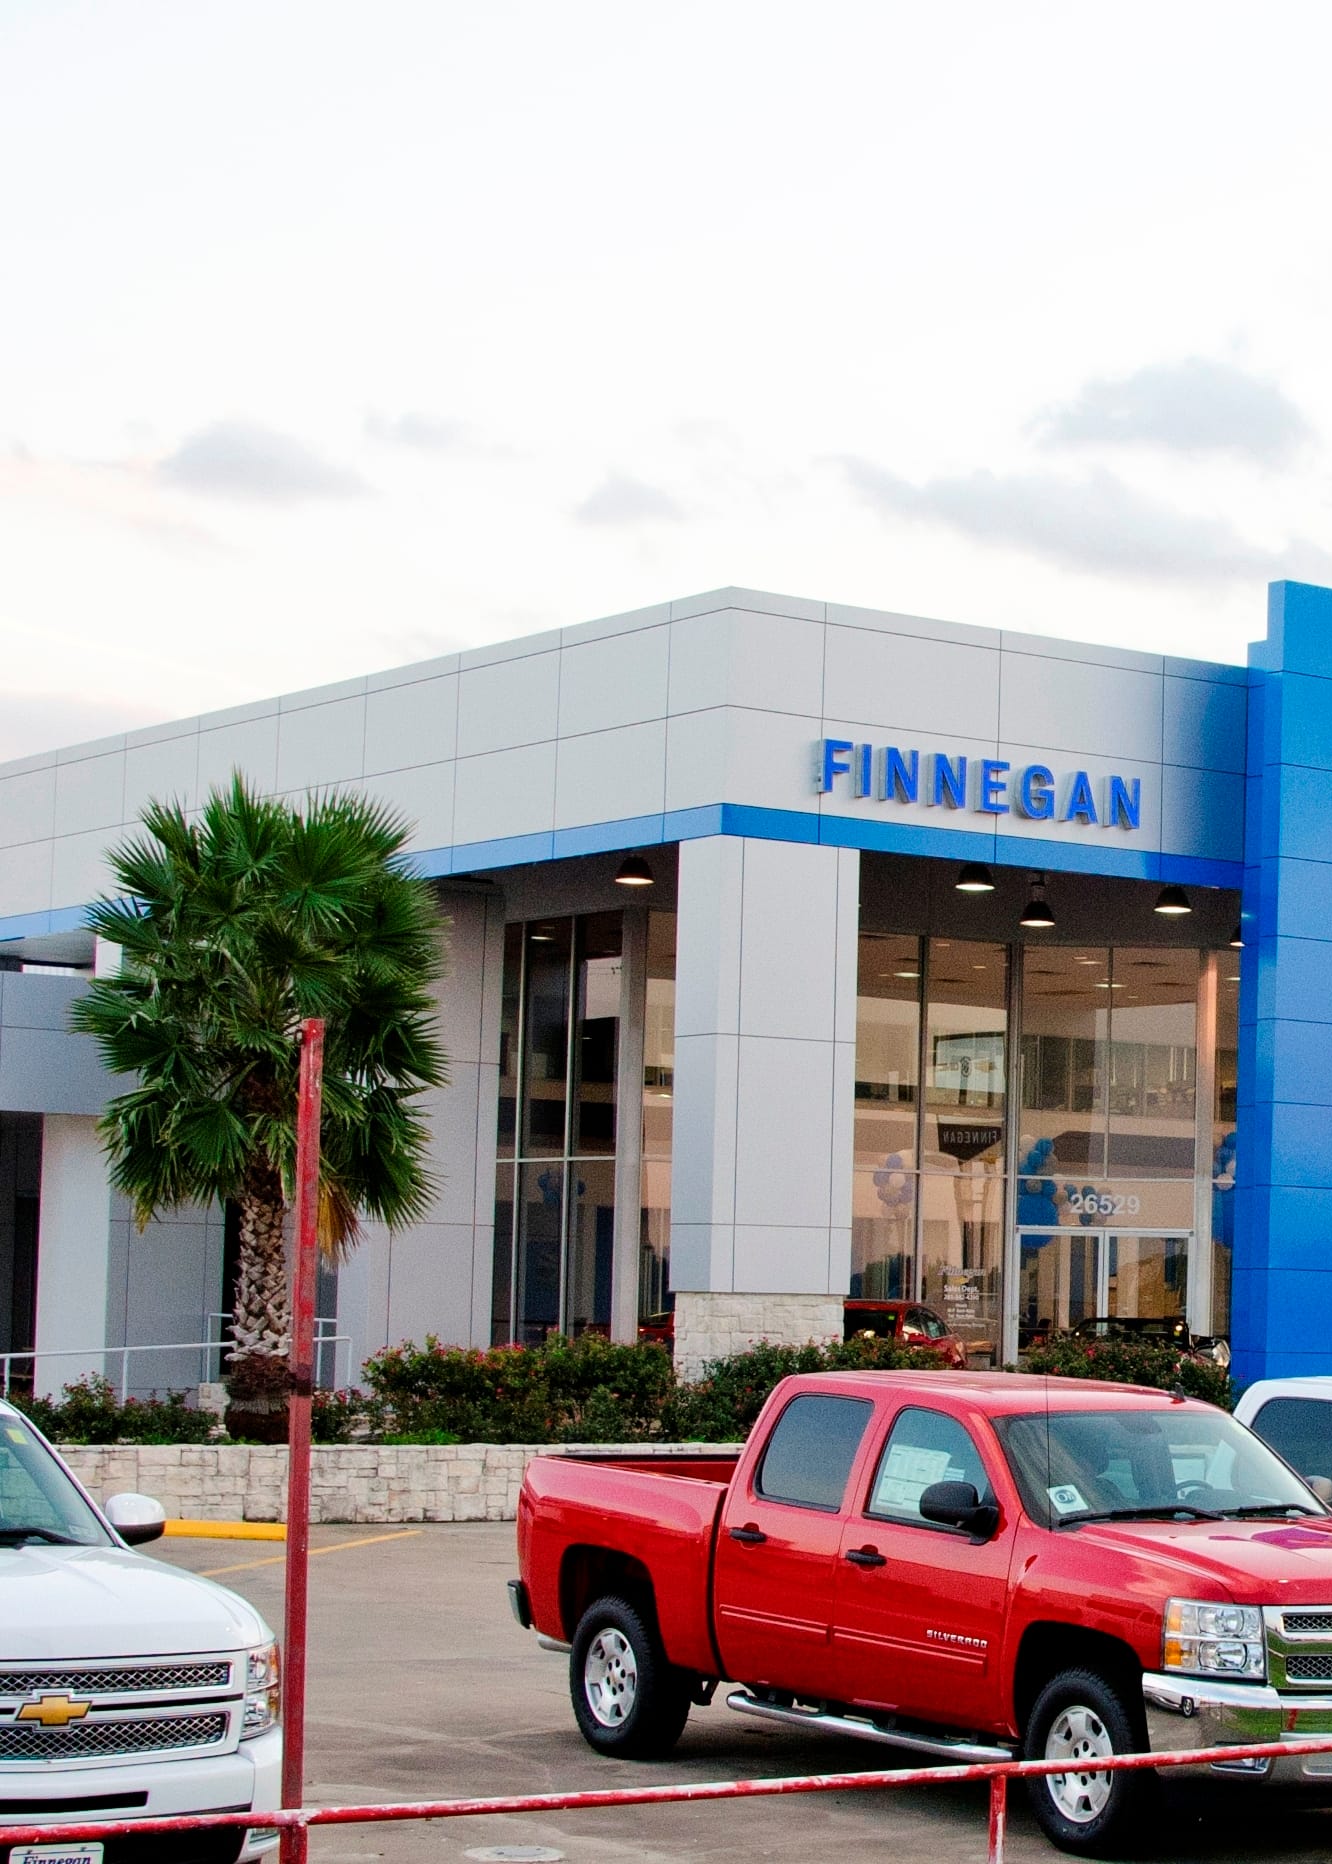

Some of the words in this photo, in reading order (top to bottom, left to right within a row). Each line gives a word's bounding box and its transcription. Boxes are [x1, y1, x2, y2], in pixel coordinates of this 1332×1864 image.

[820, 738, 1141, 830] FINNEGAN
[1070, 1193, 1139, 1214] 26529
[926, 1629, 988, 1648] SILVERADO
